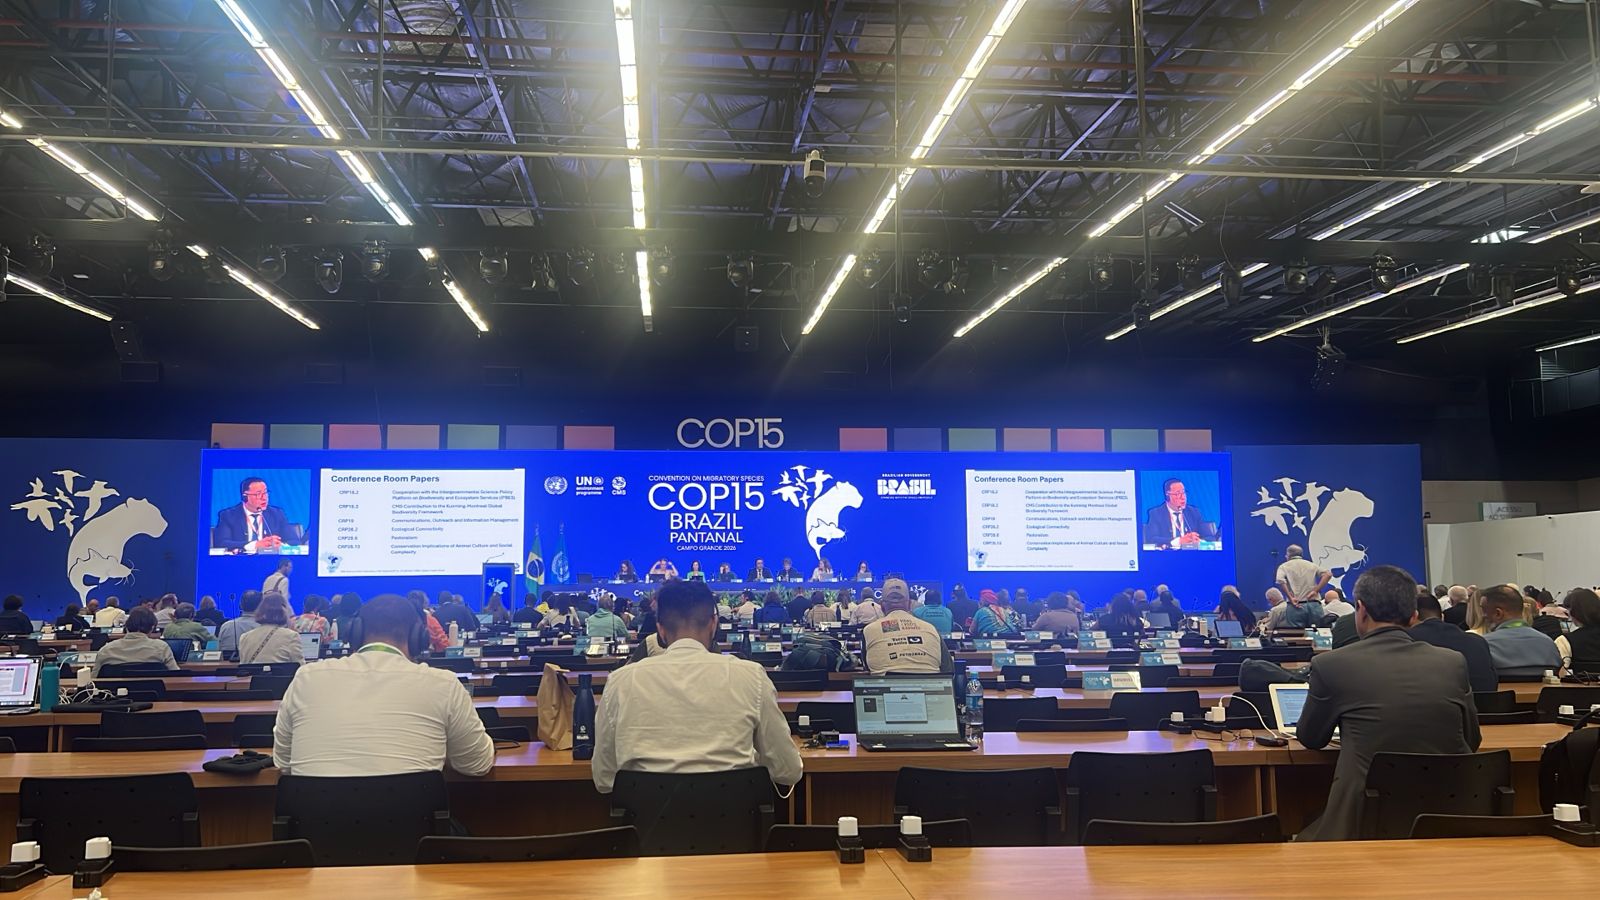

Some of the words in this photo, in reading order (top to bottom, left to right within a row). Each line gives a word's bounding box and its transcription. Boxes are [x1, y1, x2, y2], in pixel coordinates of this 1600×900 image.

[677, 418, 784, 448] COP15
[410, 475, 440, 484] Papers
[576, 476, 592, 486] UN
[1040, 475, 1064, 484] Papers
[878, 479, 936, 496] BRASIL
[648, 482, 764, 510] COP15
[670, 512, 744, 530] BRAZIL
[670, 532, 744, 543] PANTANAL
